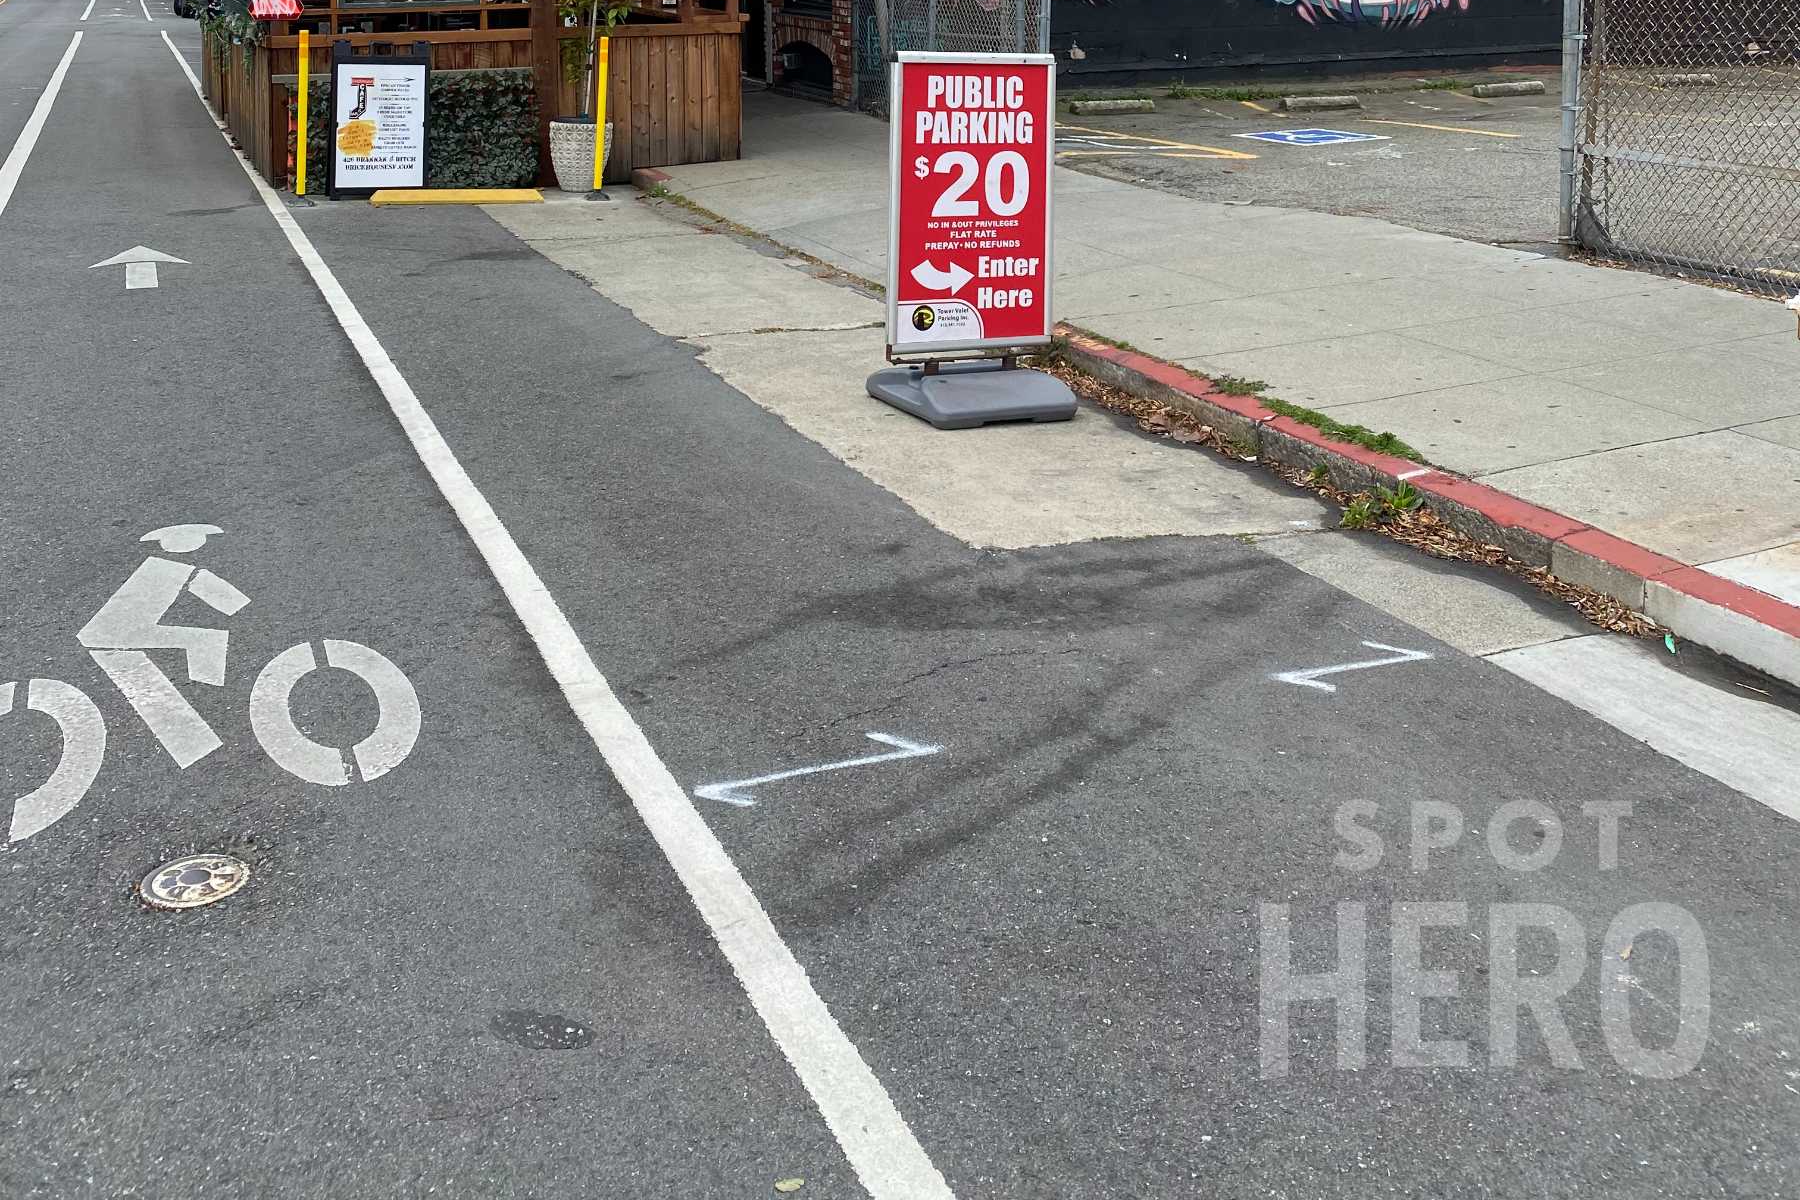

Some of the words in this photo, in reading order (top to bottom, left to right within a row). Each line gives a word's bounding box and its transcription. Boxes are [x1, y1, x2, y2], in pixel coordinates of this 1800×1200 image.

[927, 75, 1024, 109] PUBLIC
[915, 111, 1034, 145] PARKING
[914, 150, 1030, 217] $20
[974, 230, 997, 238] RATE
[979, 240, 1021, 248] REFUNDS
[978, 256, 1039, 278] Enter
[977, 286, 1033, 309] Here
